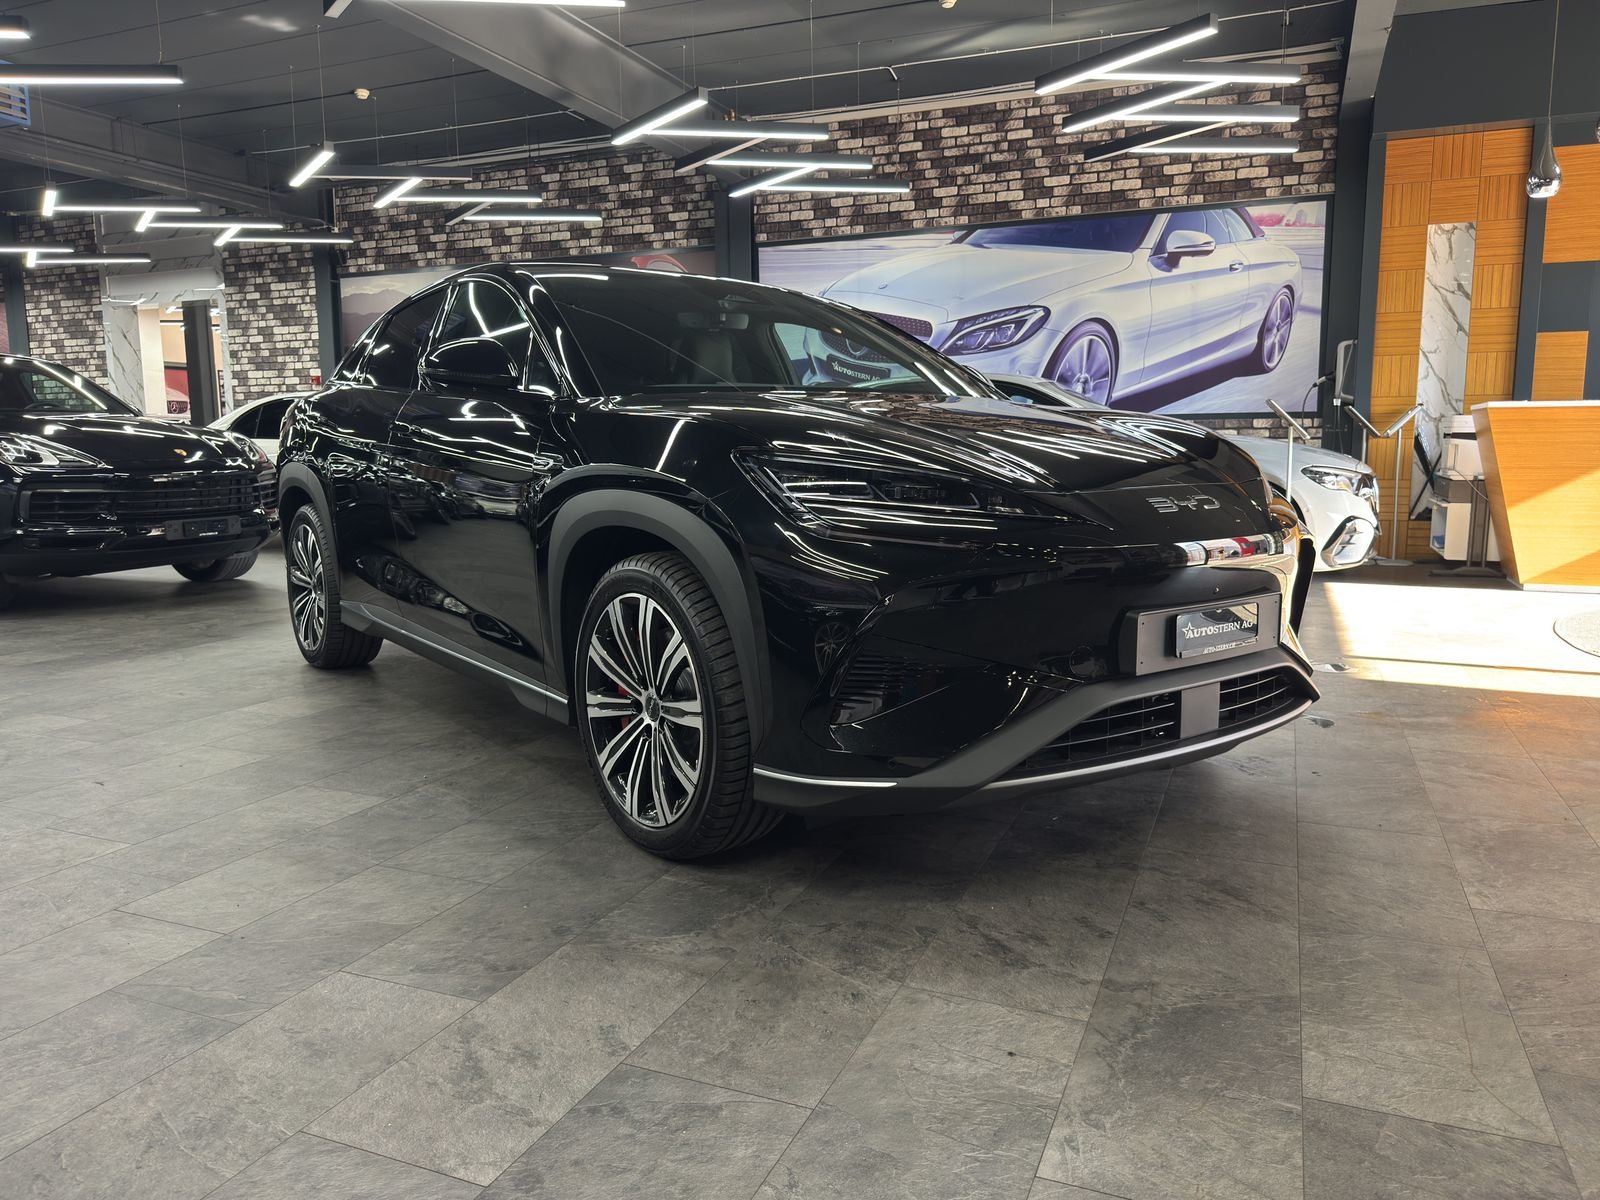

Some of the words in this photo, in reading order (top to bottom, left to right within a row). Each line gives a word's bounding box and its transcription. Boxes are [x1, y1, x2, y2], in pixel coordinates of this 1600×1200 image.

[833, 365, 871, 381] AUTOSTERN
[1146, 495, 1221, 513] BYD
[1184, 621, 1240, 639] AUTOSTERN
[1241, 620, 1254, 629] AG
